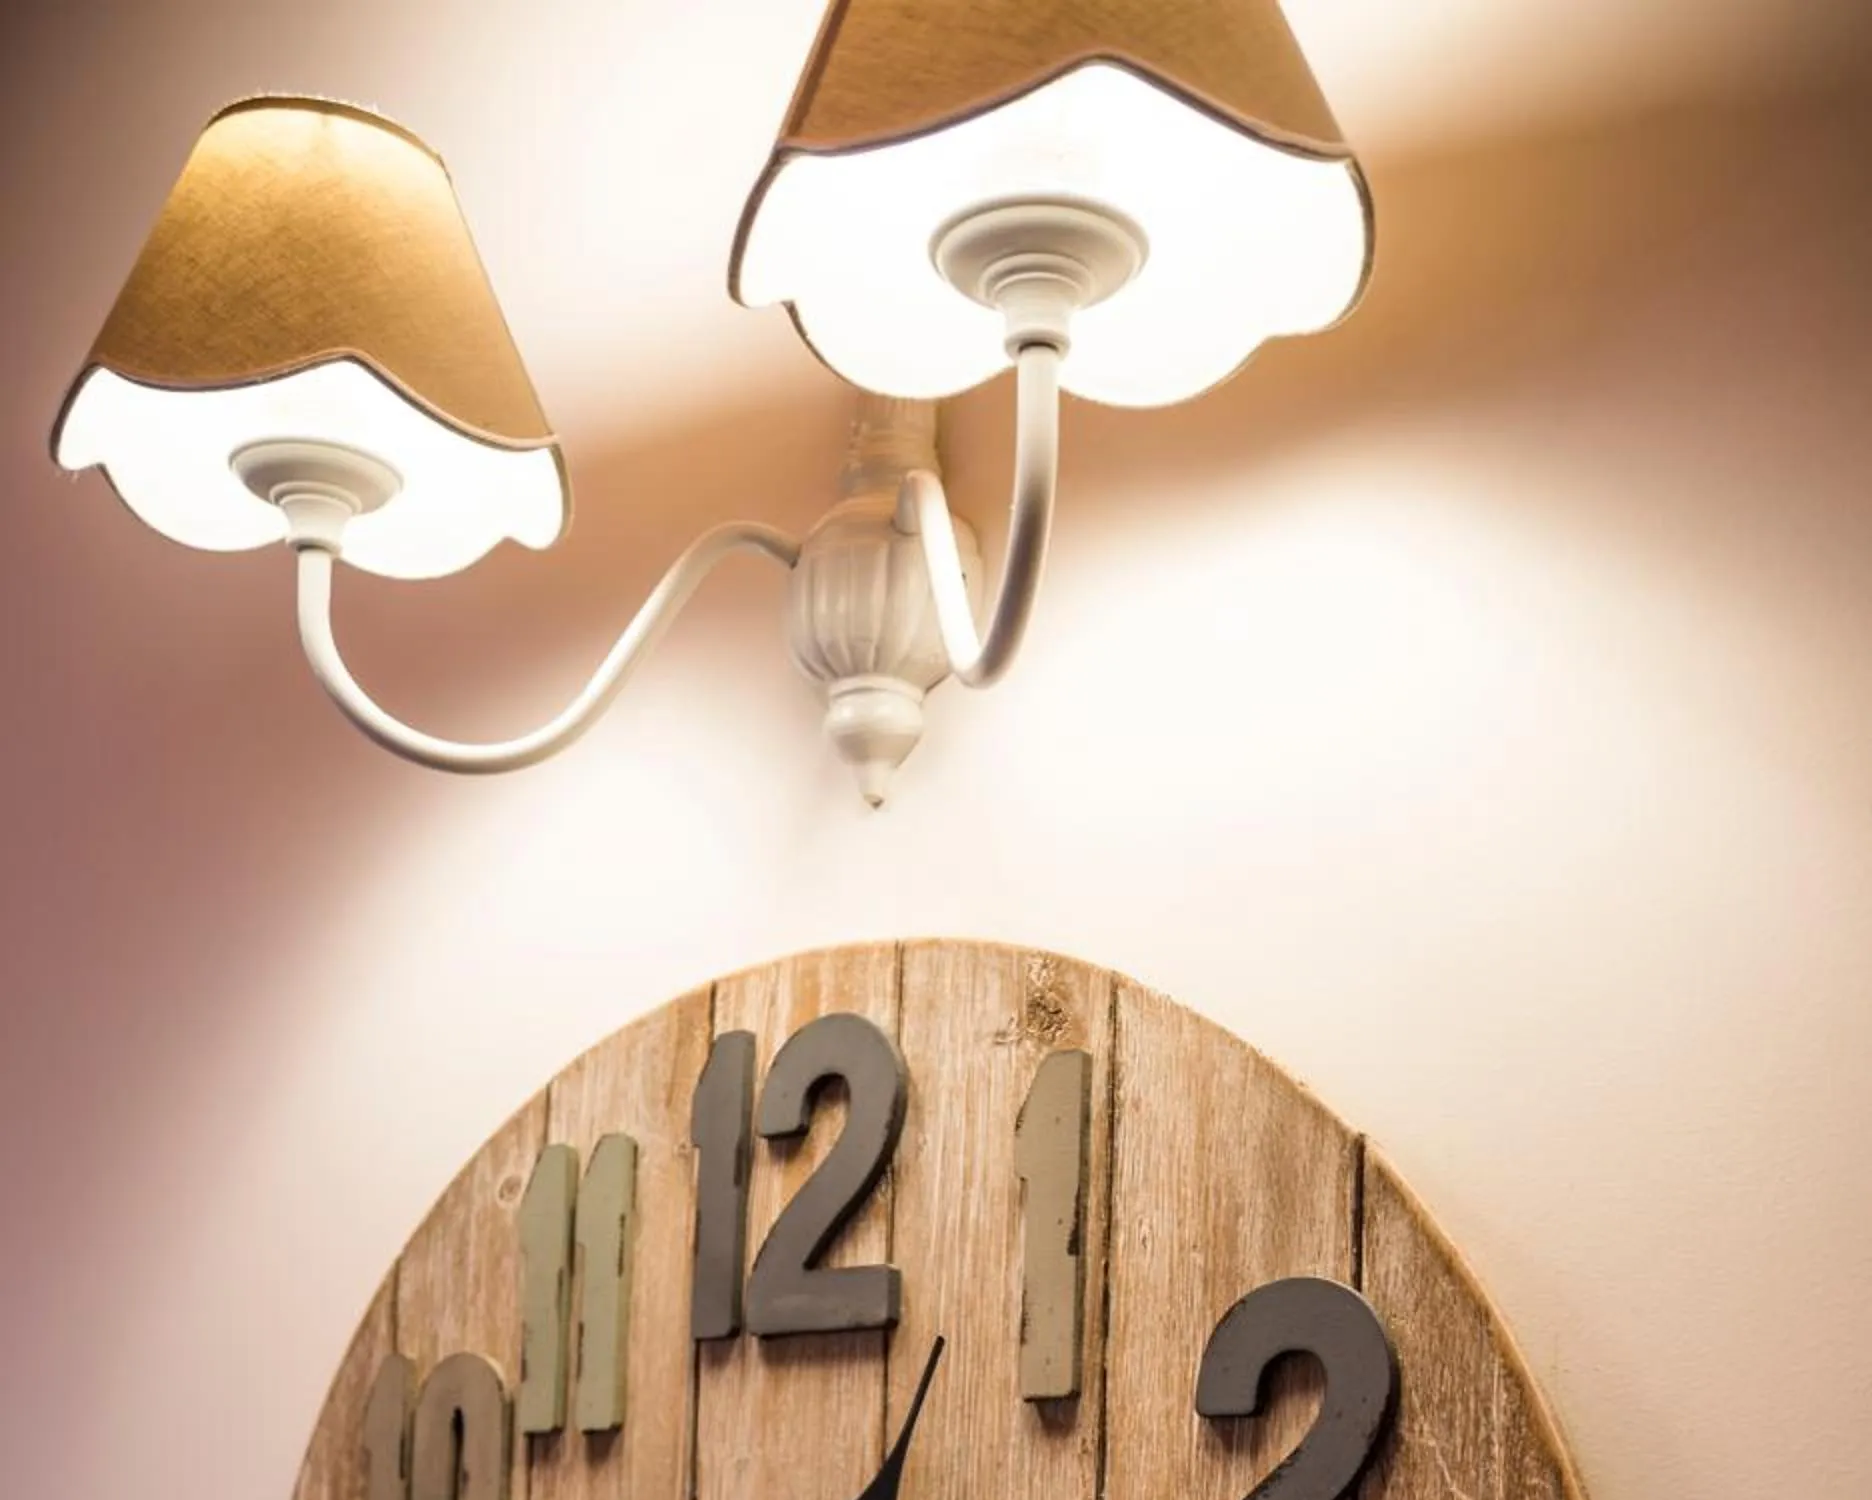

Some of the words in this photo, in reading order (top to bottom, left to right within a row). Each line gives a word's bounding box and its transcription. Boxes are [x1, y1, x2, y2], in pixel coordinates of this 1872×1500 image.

[522, 1135, 634, 1433] 11
[692, 1014, 906, 1340] 12
[1018, 1049, 1091, 1405] 1
